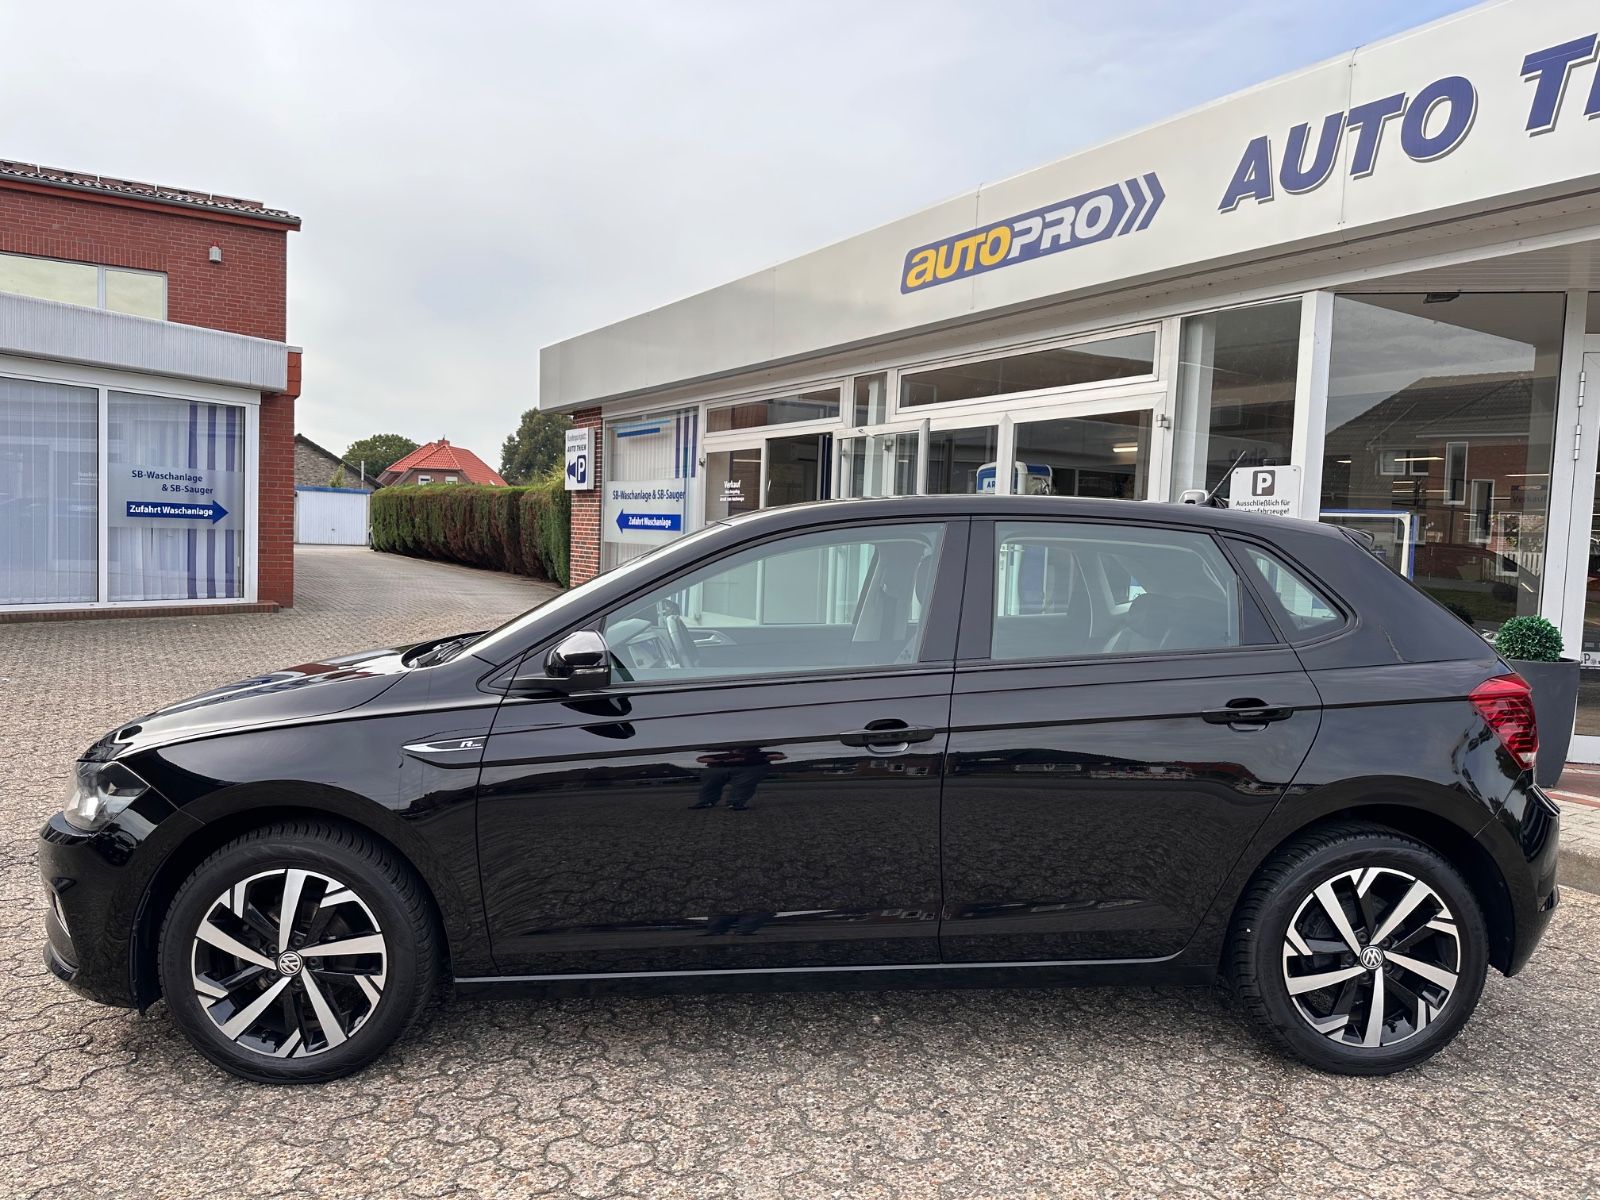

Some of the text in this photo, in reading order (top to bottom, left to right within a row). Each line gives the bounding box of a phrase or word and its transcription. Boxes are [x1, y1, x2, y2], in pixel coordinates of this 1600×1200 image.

[1218, 75, 1478, 213] AUTO
[131, 470, 203, 483] SB-Waschanlage
[161, 483, 214, 495] & SB-Sauger
[612, 489, 652, 503] SB-Waschanlage
[657, 488, 686, 502] SB-Sauger
[1235, 498, 1291, 507] Ausschließlich für
[129, 504, 214, 517] Zufahrt Waschanlage
[628, 516, 672, 528] Zufahrt Waschanlage
